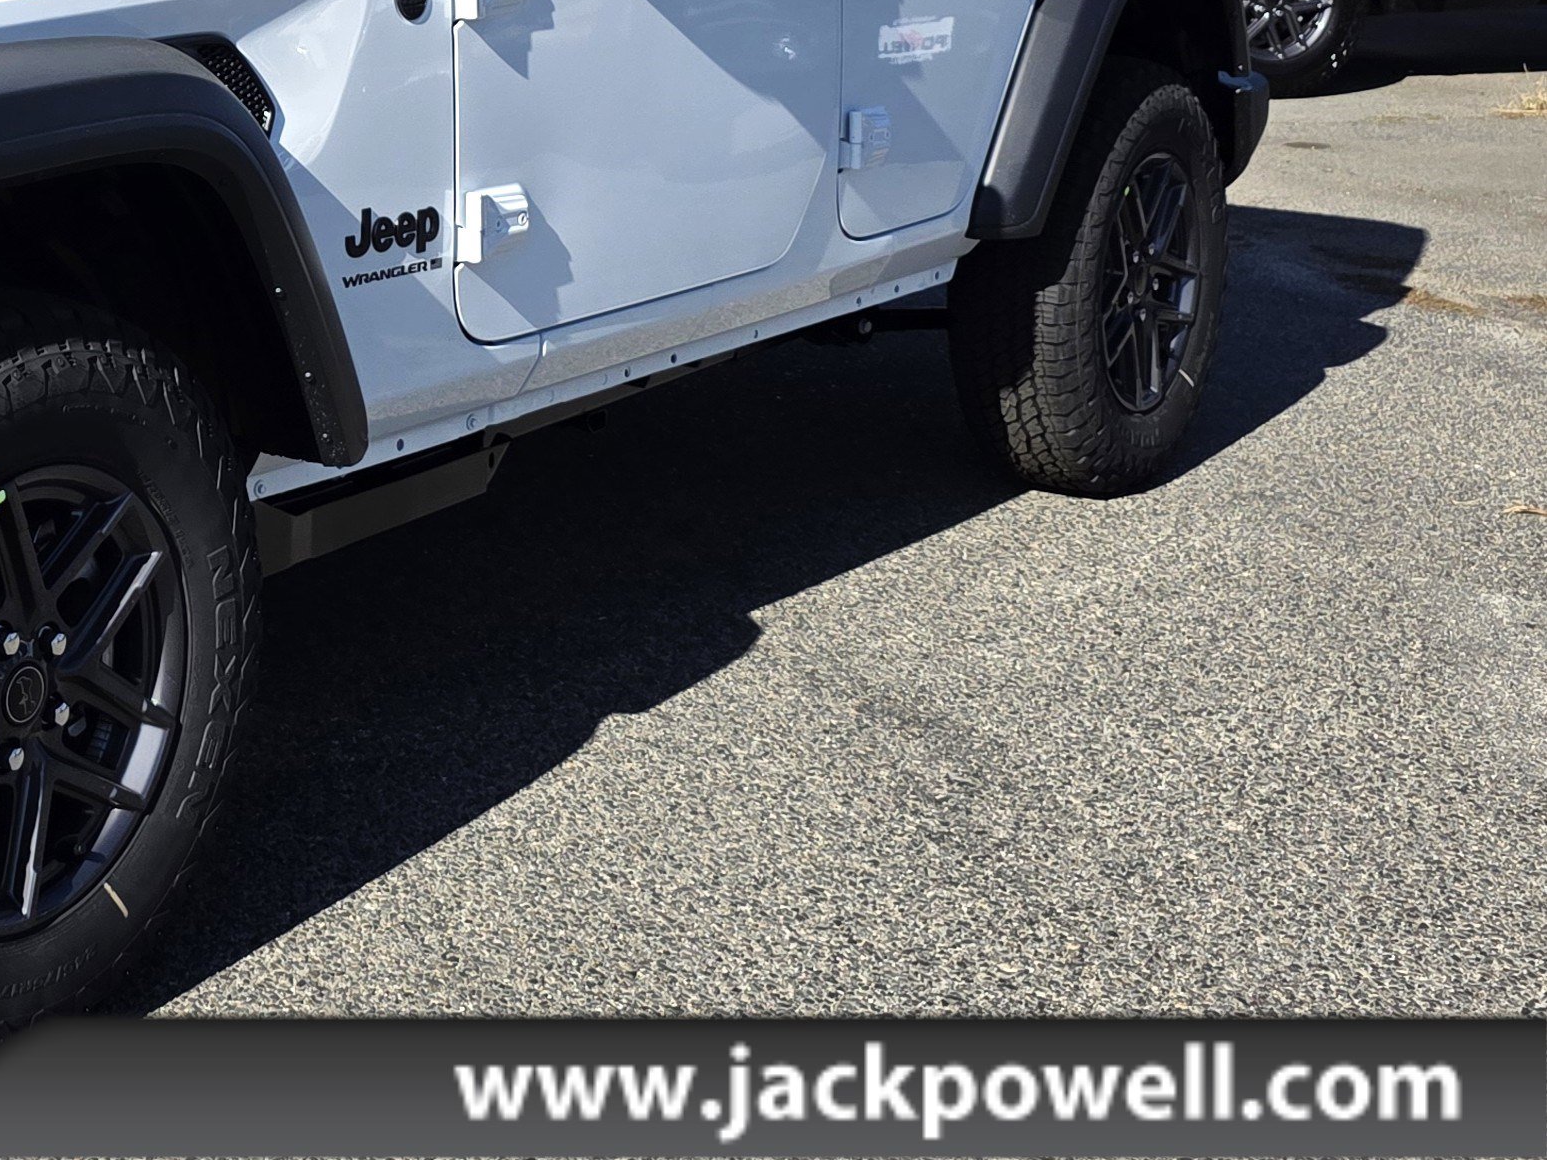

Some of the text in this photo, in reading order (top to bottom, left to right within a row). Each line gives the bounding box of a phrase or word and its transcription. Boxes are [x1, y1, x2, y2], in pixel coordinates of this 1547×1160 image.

[344, 206, 440, 258] Jeep
[342, 260, 428, 289] WRANGLER
[176, 545, 238, 820] NEXEN
